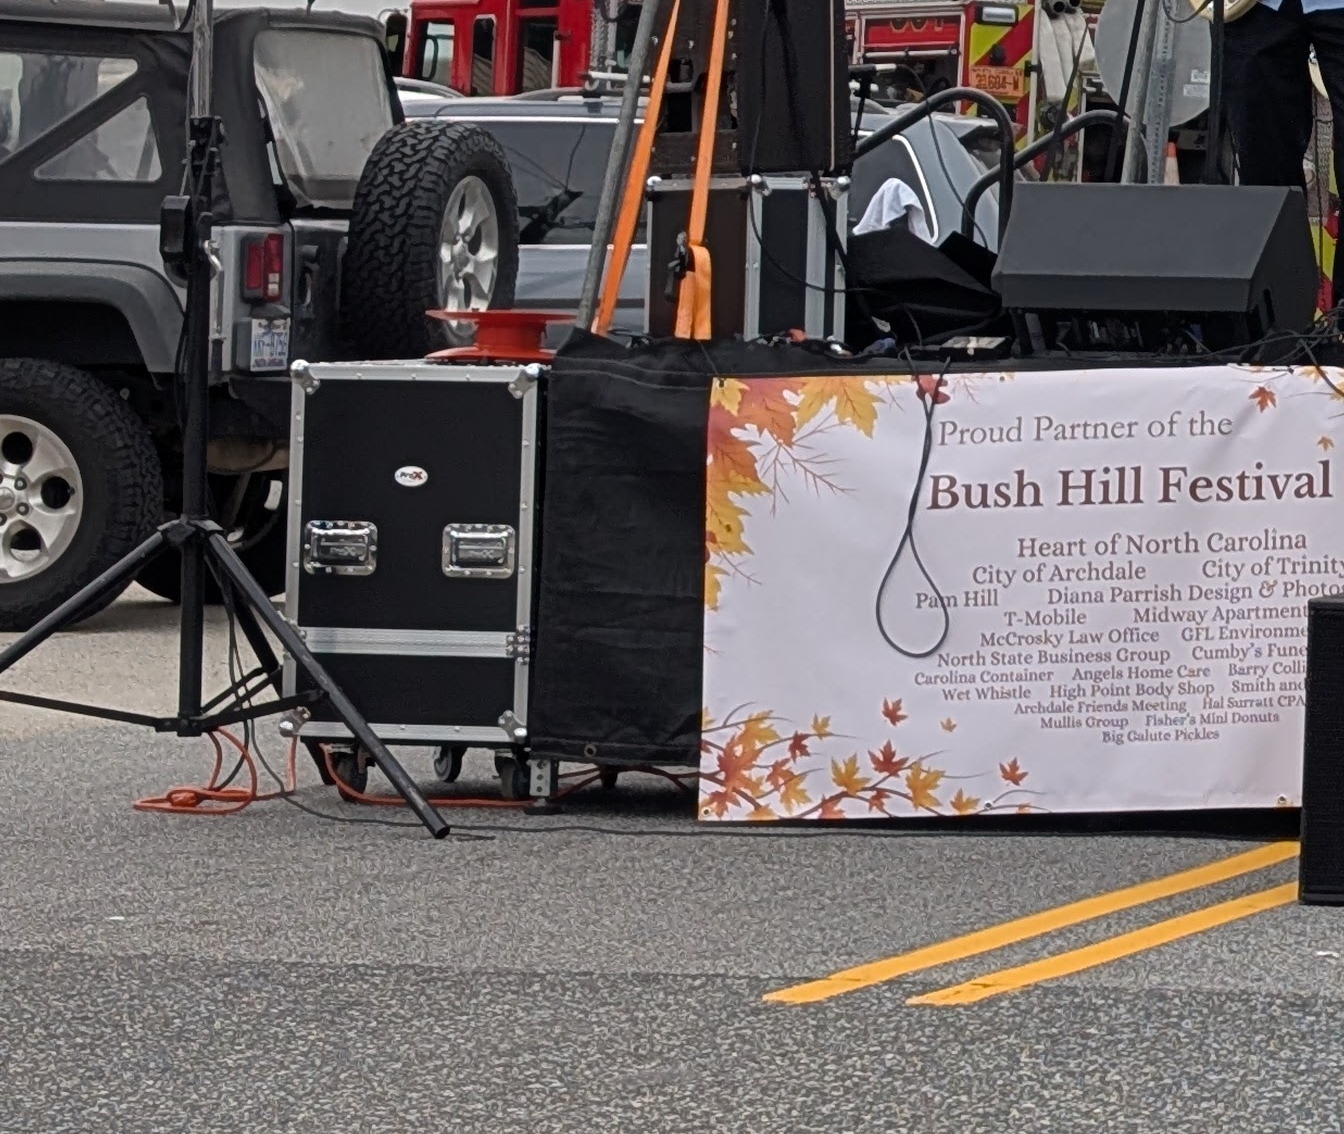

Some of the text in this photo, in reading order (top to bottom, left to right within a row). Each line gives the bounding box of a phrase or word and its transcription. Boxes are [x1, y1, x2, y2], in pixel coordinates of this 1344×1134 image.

[938, 410, 1234, 446] Proud Partner of the
[926, 460, 1333, 511] Bush Hill Festival
[1017, 527, 1307, 558] Heart of North Carolina
[972, 560, 1146, 589] City of Archdale
[1202, 558, 1245, 582] City
[1250, 556, 1275, 576] of
[916, 588, 999, 609] Pam Hill
[1047, 587, 1104, 605] Diana
[1110, 584, 1182, 603] Parrish
[1188, 584, 1253, 604] Design
[1258, 580, 1279, 599] &
[1004, 609, 1087, 627] T-Mobile
[1133, 606, 1208, 625] Midway
[980, 627, 1159, 648] McCrosky Law Office
[1181, 626, 1214, 642] GFL
[937, 647, 1171, 667] North State Business Group
[1192, 642, 1263, 662] Cumby's
[914, 668, 1054, 686] Carolina Container
[1072, 665, 1211, 683] Angels Home Care
[1228, 663, 1269, 679] Barry
[942, 685, 1032, 701] Wet Whistle
[1050, 680, 1215, 700] High Point Body Shop
[1231, 678, 1276, 694] Smith
[1014, 698, 1188, 715] Archdale Friends Meeting
[1202, 696, 1224, 710] Hal
[1227, 695, 1273, 709] Surratt
[1040, 716, 1129, 731] Mullis Group
[1145, 711, 1280, 727] Fisher's Mini Donuts
[1102, 731, 1124, 746] Big
[1175, 728, 1220, 742] Pickles
